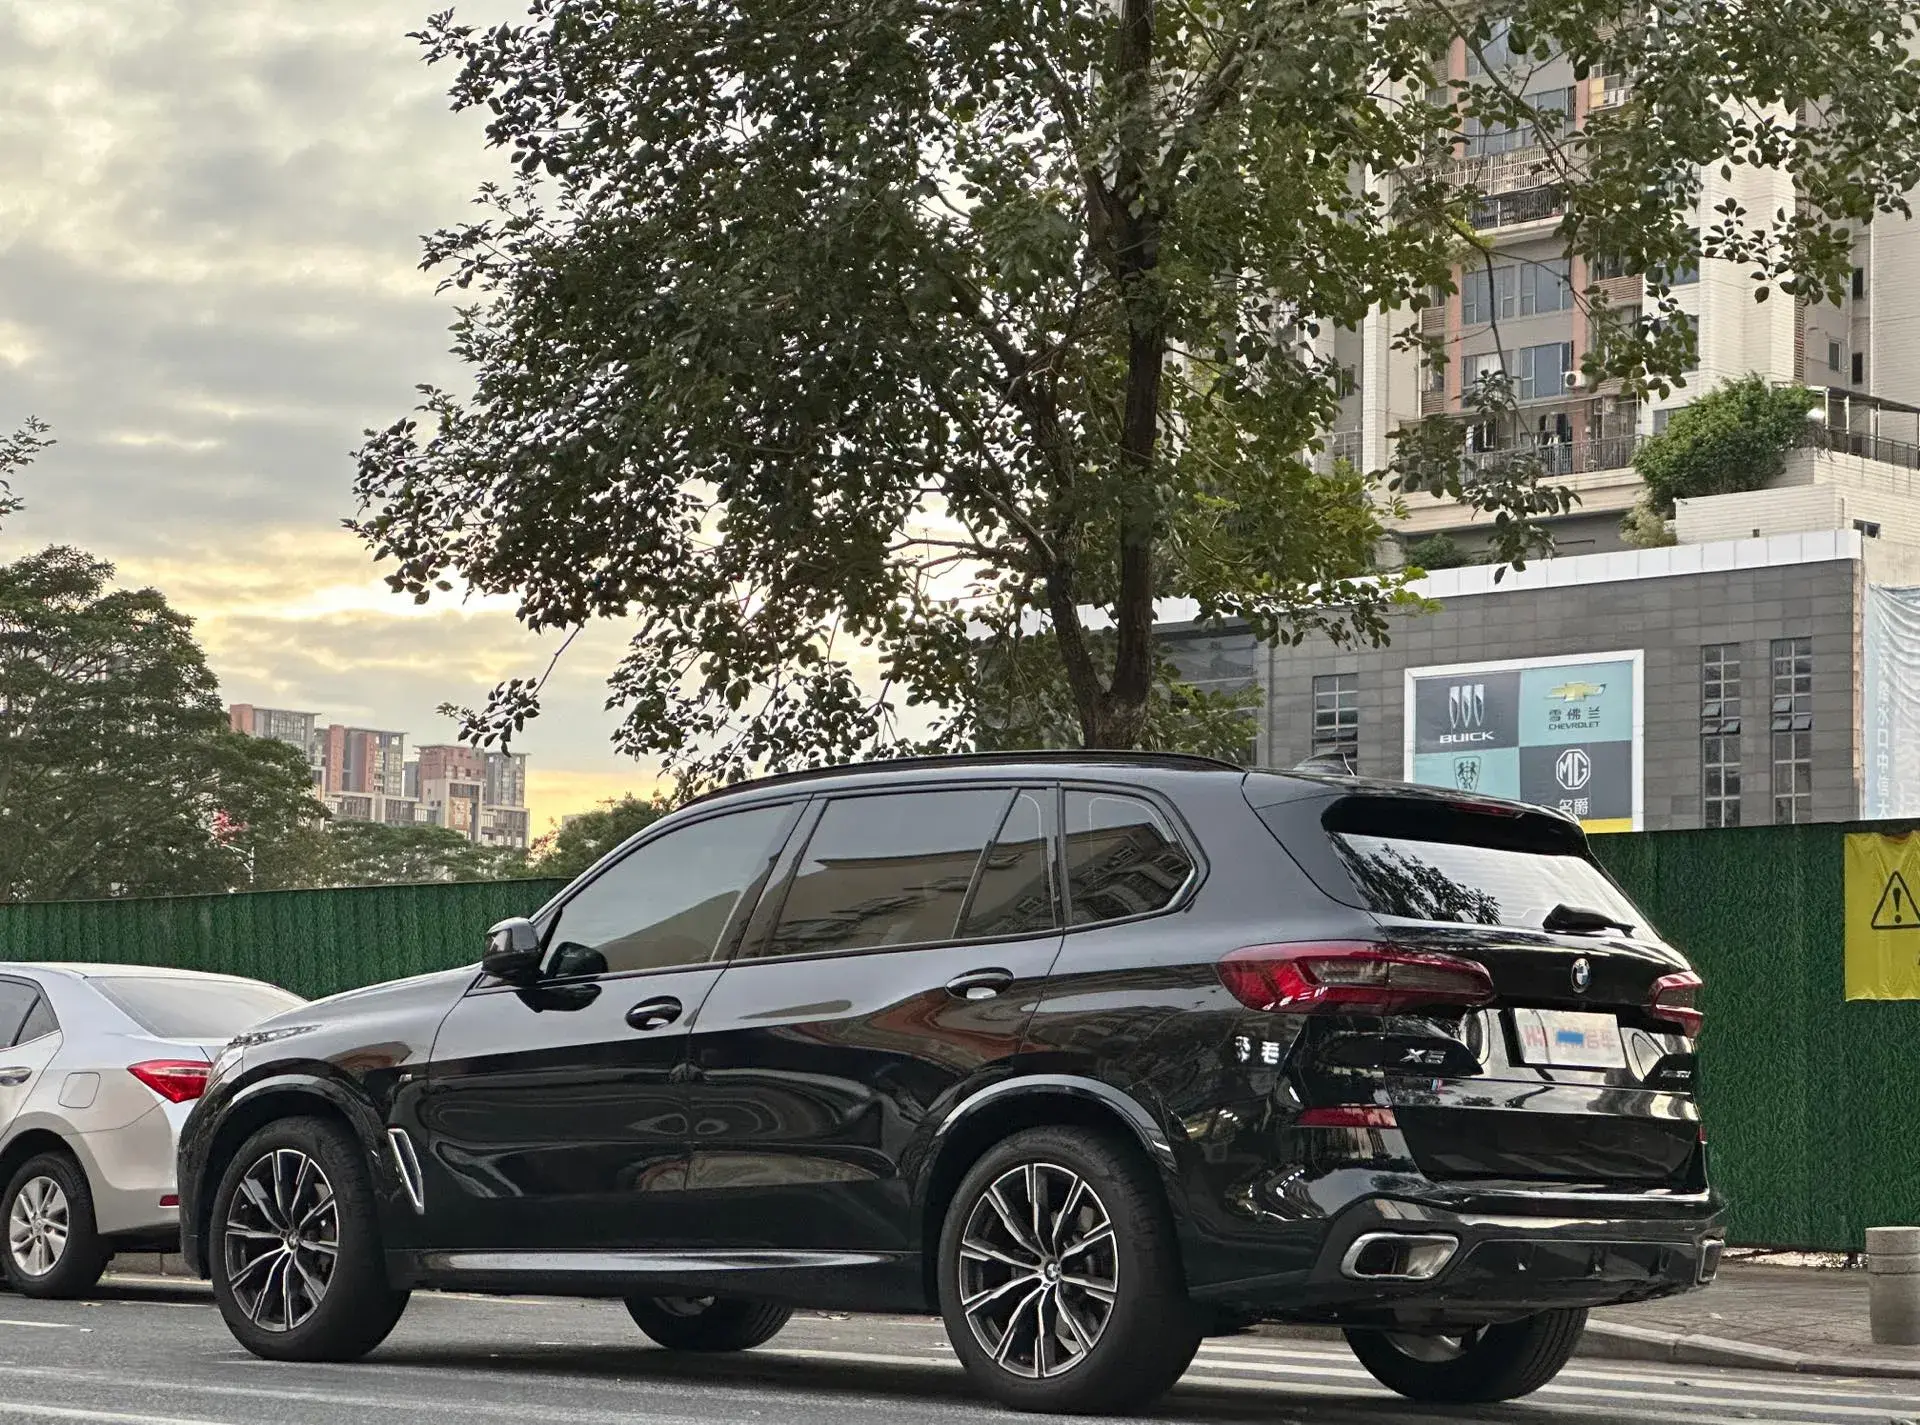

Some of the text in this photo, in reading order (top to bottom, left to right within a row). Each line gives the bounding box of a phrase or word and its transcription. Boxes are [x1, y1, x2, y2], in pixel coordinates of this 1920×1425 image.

[1549, 706, 1600, 722] 雪佛兰
[1548, 720, 1600, 730] CHEVROLET
[1439, 731, 1495, 744] BUICK
[1559, 752, 1588, 787] MG
[1559, 797, 1588, 815] 名爵
[1400, 1048, 1446, 1064] X5
